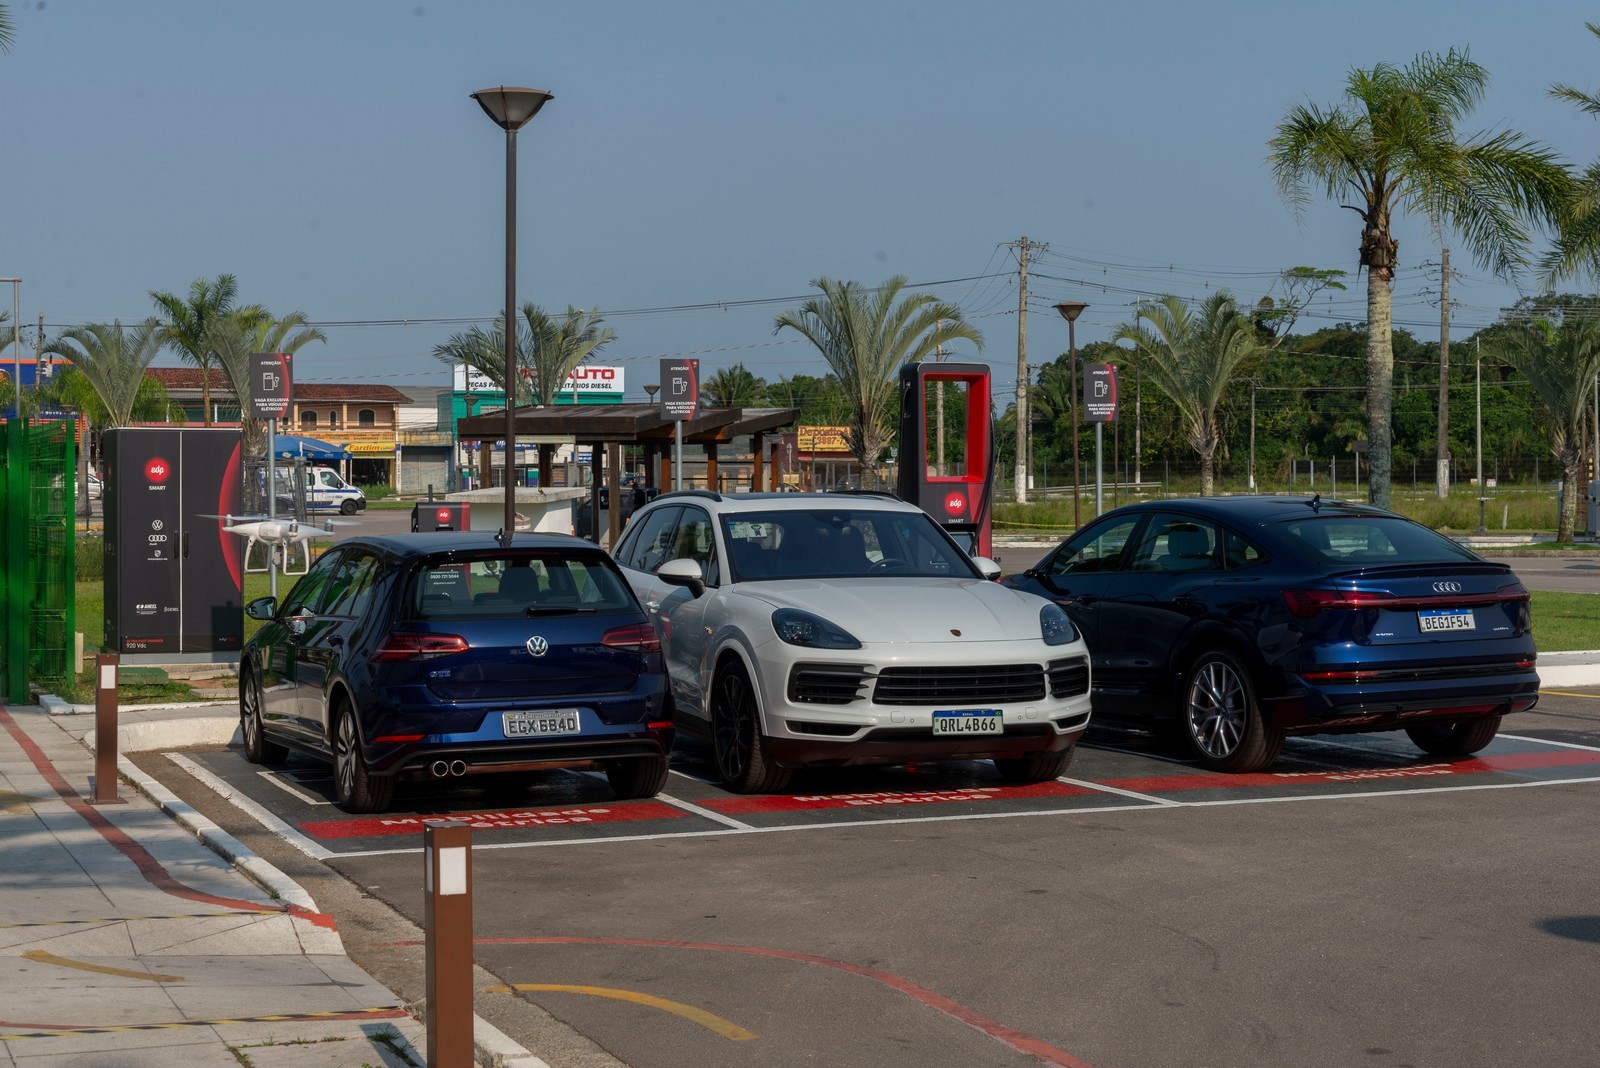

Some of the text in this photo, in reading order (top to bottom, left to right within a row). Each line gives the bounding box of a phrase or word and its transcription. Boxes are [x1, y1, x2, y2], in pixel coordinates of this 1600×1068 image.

[150, 465, 164, 475] edp
[949, 499, 962, 508] edp
[1425, 616, 1469, 630] BEG1F54
[940, 717, 997, 732] QRL4B66
[380, 808, 611, 826] Mobilidade
[470, 816, 592, 828] étrica
